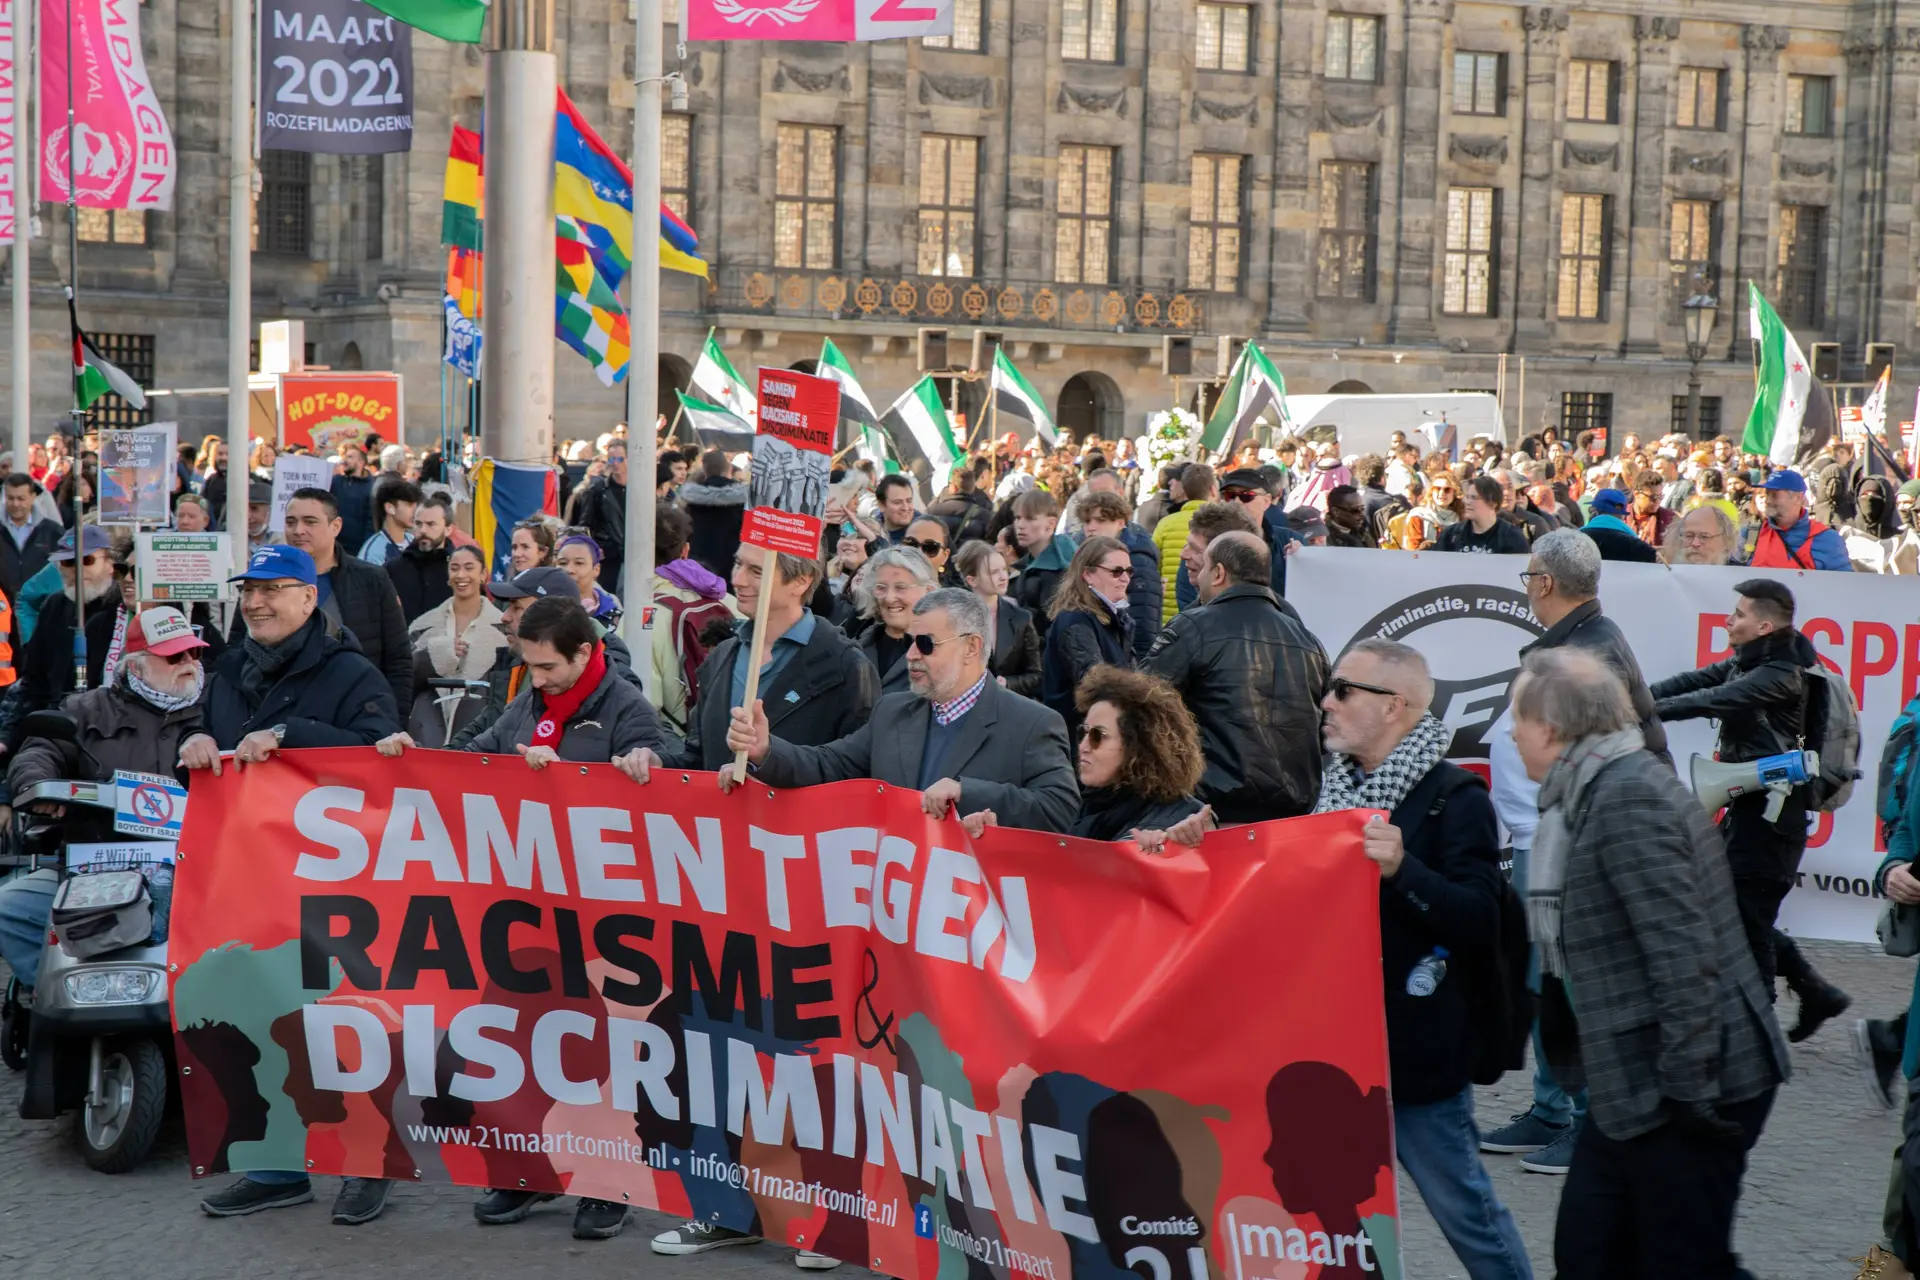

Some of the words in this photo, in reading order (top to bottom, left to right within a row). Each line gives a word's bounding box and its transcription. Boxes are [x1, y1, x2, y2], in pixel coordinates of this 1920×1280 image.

[273, 56, 403, 106] 2022
[762, 379, 797, 399] SAMEN
[764, 392, 791, 410] TEGEN
[288, 392, 392, 421] HOT-DOGS
[761, 405, 801, 427] RACISME
[801, 415, 808, 428] &
[762, 418, 830, 446] DISCRIMINATIE
[1370, 596, 1471, 640] riminatie,
[117, 771, 137, 780] FREE
[141, 774, 181, 787] PALESTIN
[117, 823, 155, 834] BOYCOTT
[157, 829, 181, 839] ISRAE
[293, 785, 727, 914] SAMEN
[749, 825, 1037, 983] TEGEN
[300, 895, 841, 1041] RACISME
[854, 947, 897, 1055] &
[302, 1003, 1100, 1244] DISCRIMINATIE
[407, 1124, 667, 1169] www.21maartcomite.nl
[690, 1149, 898, 1228] info@21maartcomite.nl
[1120, 1215, 1200, 1237] Comité
[1241, 1223, 1376, 1272] maart
